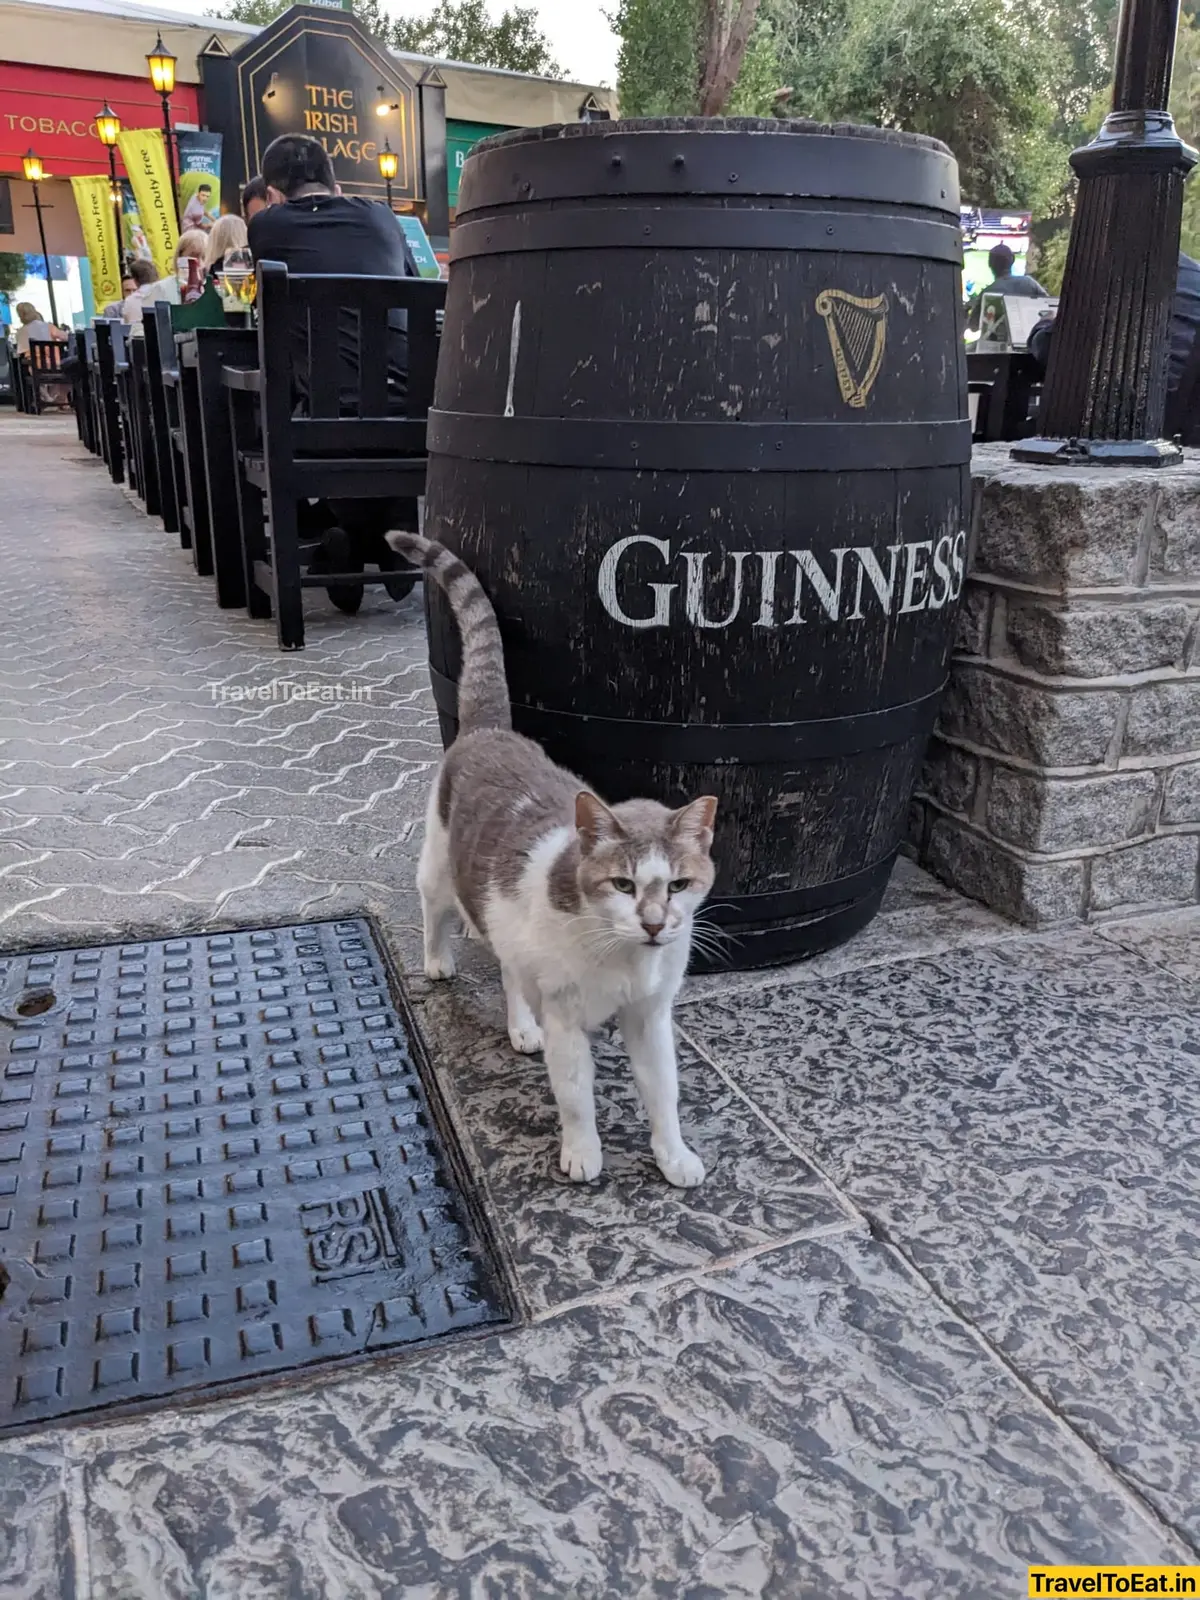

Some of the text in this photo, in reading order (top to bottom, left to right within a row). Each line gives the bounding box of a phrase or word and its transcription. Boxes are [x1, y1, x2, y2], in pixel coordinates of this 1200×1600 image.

[304, 84, 354, 110] THE
[4, 114, 102, 138] TOBACC
[304, 109, 358, 135] IRISH
[140, 149, 155, 176] Free
[320, 136, 377, 164] LAGE
[91, 193, 101, 215] Free
[149, 178, 164, 209] Duty
[598, 530, 967, 629] GUINNESS
